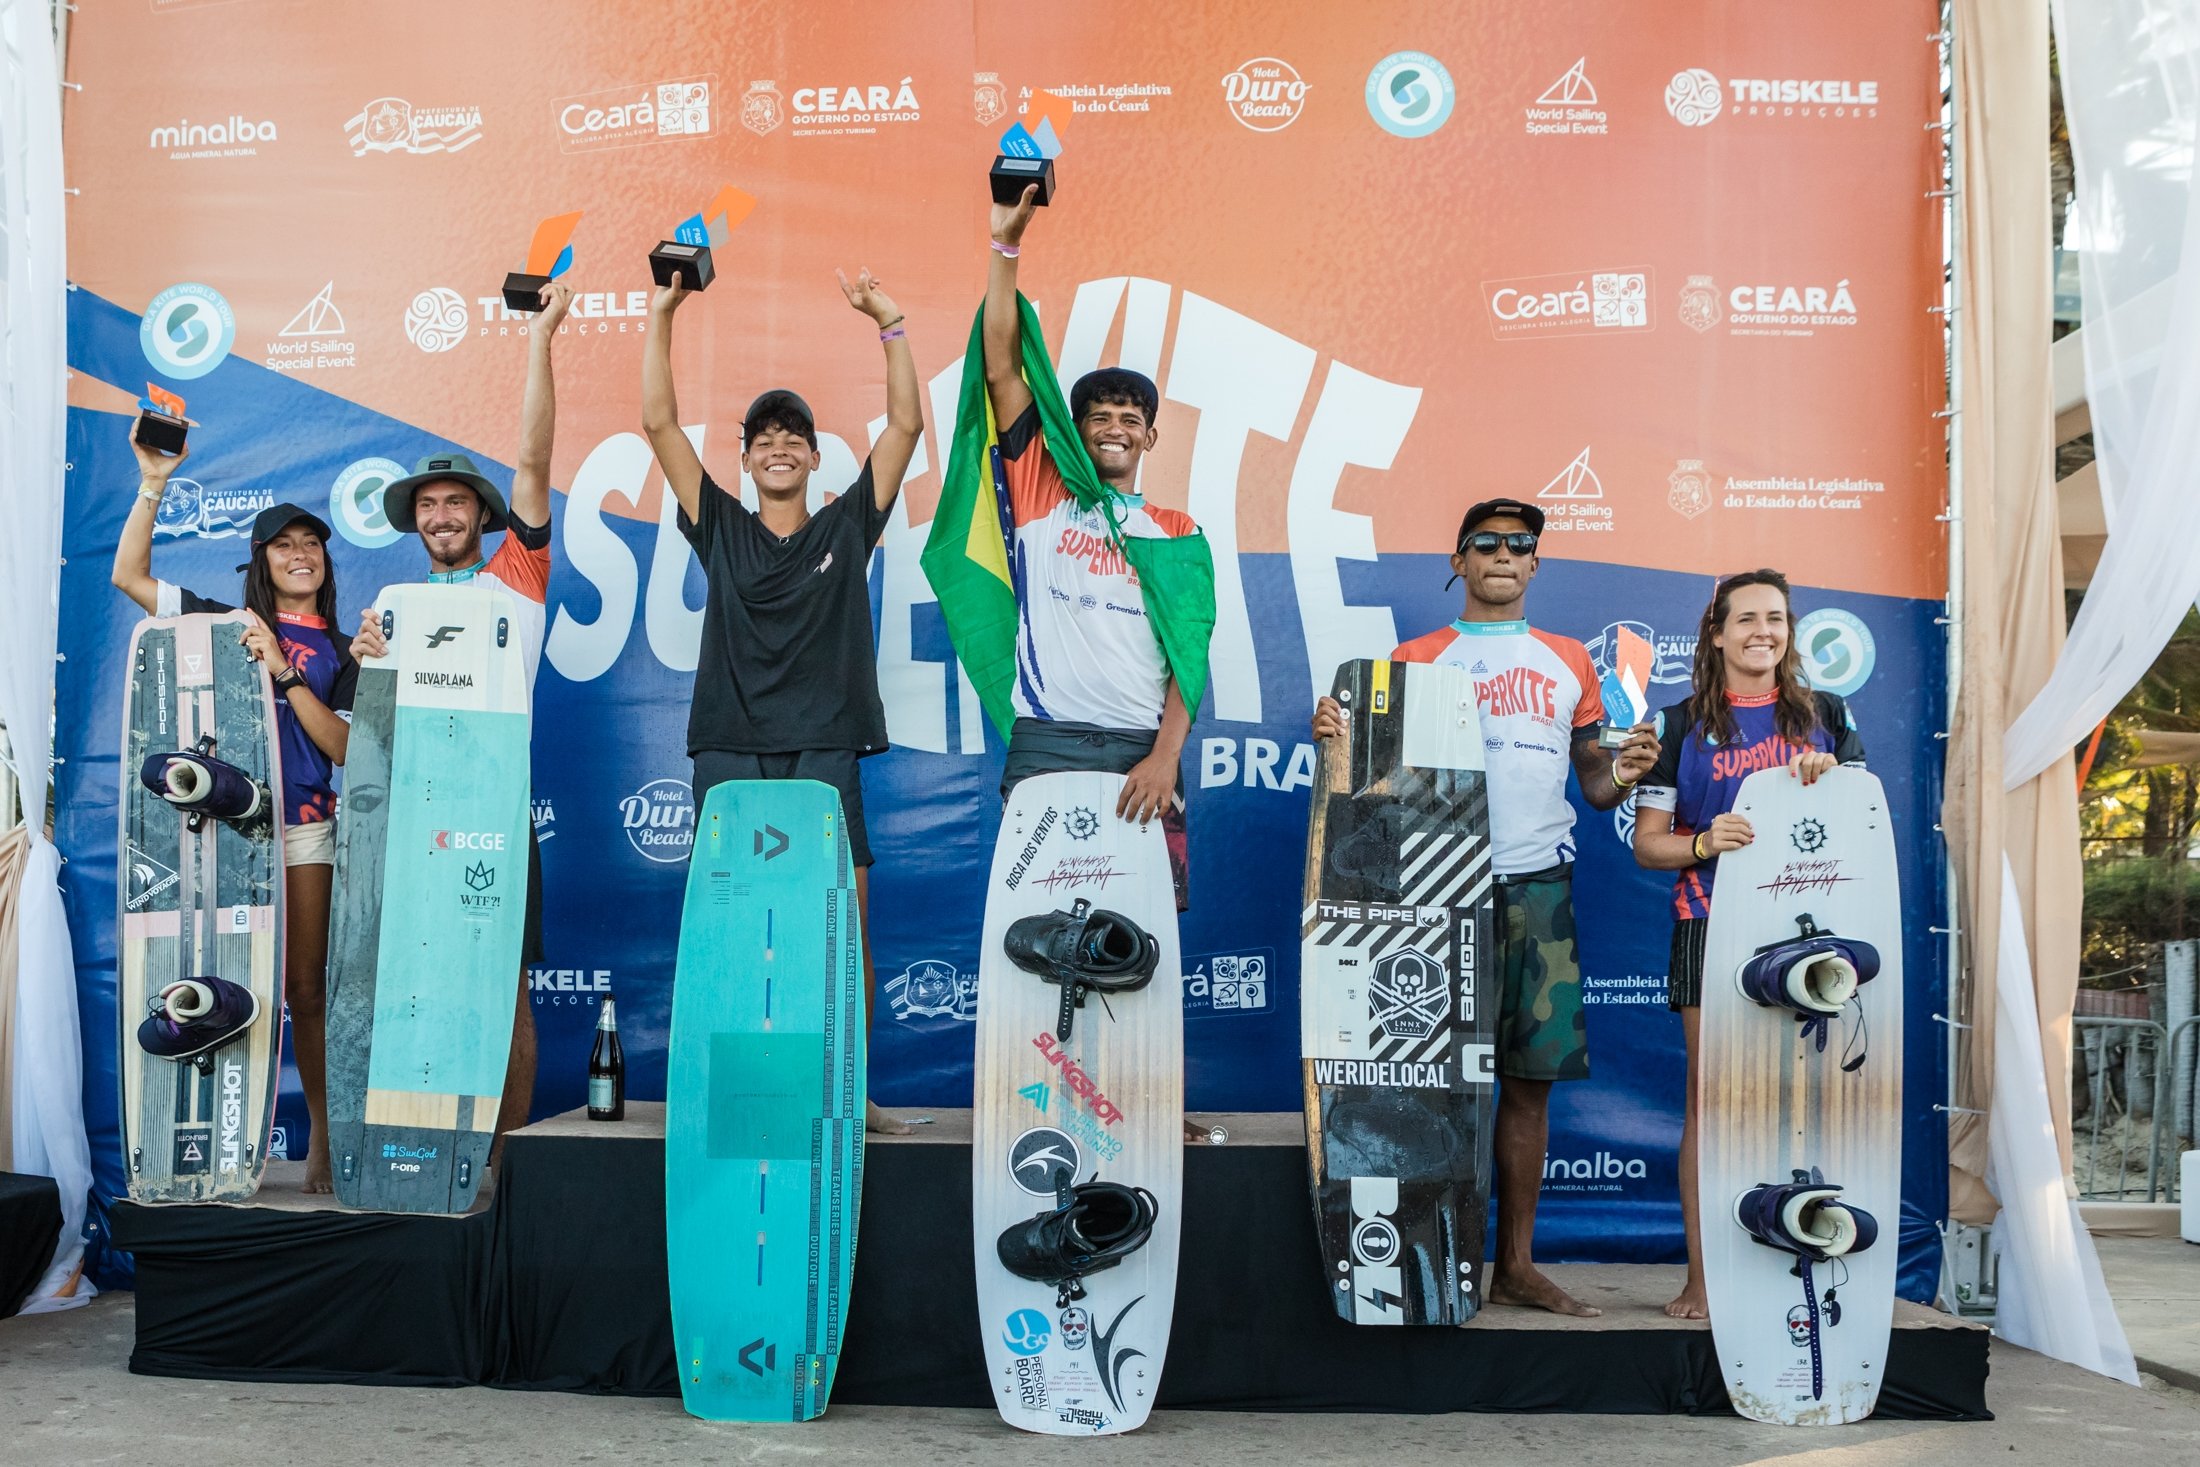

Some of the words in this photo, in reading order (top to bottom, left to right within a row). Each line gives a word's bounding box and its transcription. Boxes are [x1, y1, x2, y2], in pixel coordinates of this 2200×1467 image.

[1253, 67, 1280, 78] Hotel
[792, 76, 919, 112] CEARÁ
[1099, 83, 1172, 99] Legislativa
[1222, 73, 1312, 102] Duro
[1729, 79, 1878, 104] TRISKELE
[415, 107, 465, 115] PREFEITURA
[560, 92, 654, 134] Ceará
[1088, 100, 1106, 113] do
[1109, 98, 1149, 113] Ceará
[1241, 102, 1293, 118] Beach
[1732, 105, 1878, 119] PRODUÇÕES
[412, 113, 482, 129] CAUCAIA
[792, 114, 850, 125] GOVERNO
[853, 114, 871, 123] DO
[873, 112, 920, 122] ESTADO
[1526, 108, 1562, 121] World
[1565, 108, 1607, 123] Sailing
[150, 115, 277, 148] minalba
[1526, 122, 1568, 136] Special
[1571, 121, 1608, 135] Event
[191, 150, 222, 160] MINERAL
[223, 148, 257, 157] NATURAL
[1491, 280, 1590, 321] Ceará
[1729, 278, 1857, 314] CEARÁ
[179, 285, 217, 302] WORLD
[215, 300, 233, 328] TOUR
[1730, 314, 1789, 324] GOVERNO
[1791, 315, 1809, 324] DO
[1811, 315, 1857, 325] ESTADO
[480, 322, 645, 336] PROUÇÕES
[267, 341, 307, 355] World
[310, 340, 355, 354] Sailing
[266, 356, 314, 373] Special
[317, 355, 355, 368] Event
[365, 460, 402, 475] WORLD
[207, 489, 260, 497] PREFEITURA
[1724, 476, 1805, 491] Assembleia
[1809, 477, 1884, 493] Legislativa
[203, 496, 275, 512] CAUCAIA
[1724, 494, 1743, 508] do
[1745, 494, 1794, 508] Estado
[1797, 495, 1816, 508] do
[1819, 494, 1861, 509] Ceará
[1569, 504, 1613, 519] Sailing
[1576, 519, 1614, 531] Event
[1106, 603, 1141, 616] Greenish
[414, 672, 474, 687] SILVAPLANA
[158, 647, 167, 735] PORSCHE
[652, 790, 683, 802] Hotel
[454, 832, 505, 850] BCGE
[639, 829, 694, 846] Beach
[1005, 862, 1026, 891] ROSA
[1019, 842, 1038, 868] DOS
[1032, 806, 1059, 847] VENTOS
[127, 893, 150, 911] WIND
[148, 874, 181, 897] VOYAGER
[827, 890, 837, 938] DUOTONE
[1319, 905, 1361, 919] THE
[1368, 907, 1414, 922] PIPE
[846, 938, 856, 1003] TEAMSERIES
[1460, 918, 1475, 1022] CORE
[1583, 975, 1661, 988] Assembleia
[1583, 992, 1600, 1004] do
[1603, 992, 1649, 1004] Estado
[825, 1003, 835, 1051] DUOTONE
[1395, 1020, 1420, 1028] LNNX
[843, 1053, 854, 1118] TEAMSERIES
[1032, 1031, 1124, 1126] SLINGSHOT
[219, 1060, 242, 1176] SLINGSHOT
[177, 1134, 208, 1142] BRUNOTTI
[812, 1119, 822, 1168] DUOTONE
[853, 1119, 863, 1170] DUOTONE
[397, 1145, 437, 1161] SunGod
[1587, 1184, 1623, 1192] NATURAL
[830, 1169, 841, 1236] TEAMSERIES
[808, 1235, 819, 1285] DUOTONE
[827, 1286, 838, 1354] TEAMSERIES
[794, 1354, 805, 1407] DUOTONE
[1016, 1357, 1036, 1407] BOARD
[1031, 1356, 1049, 1409] PERSONAL
